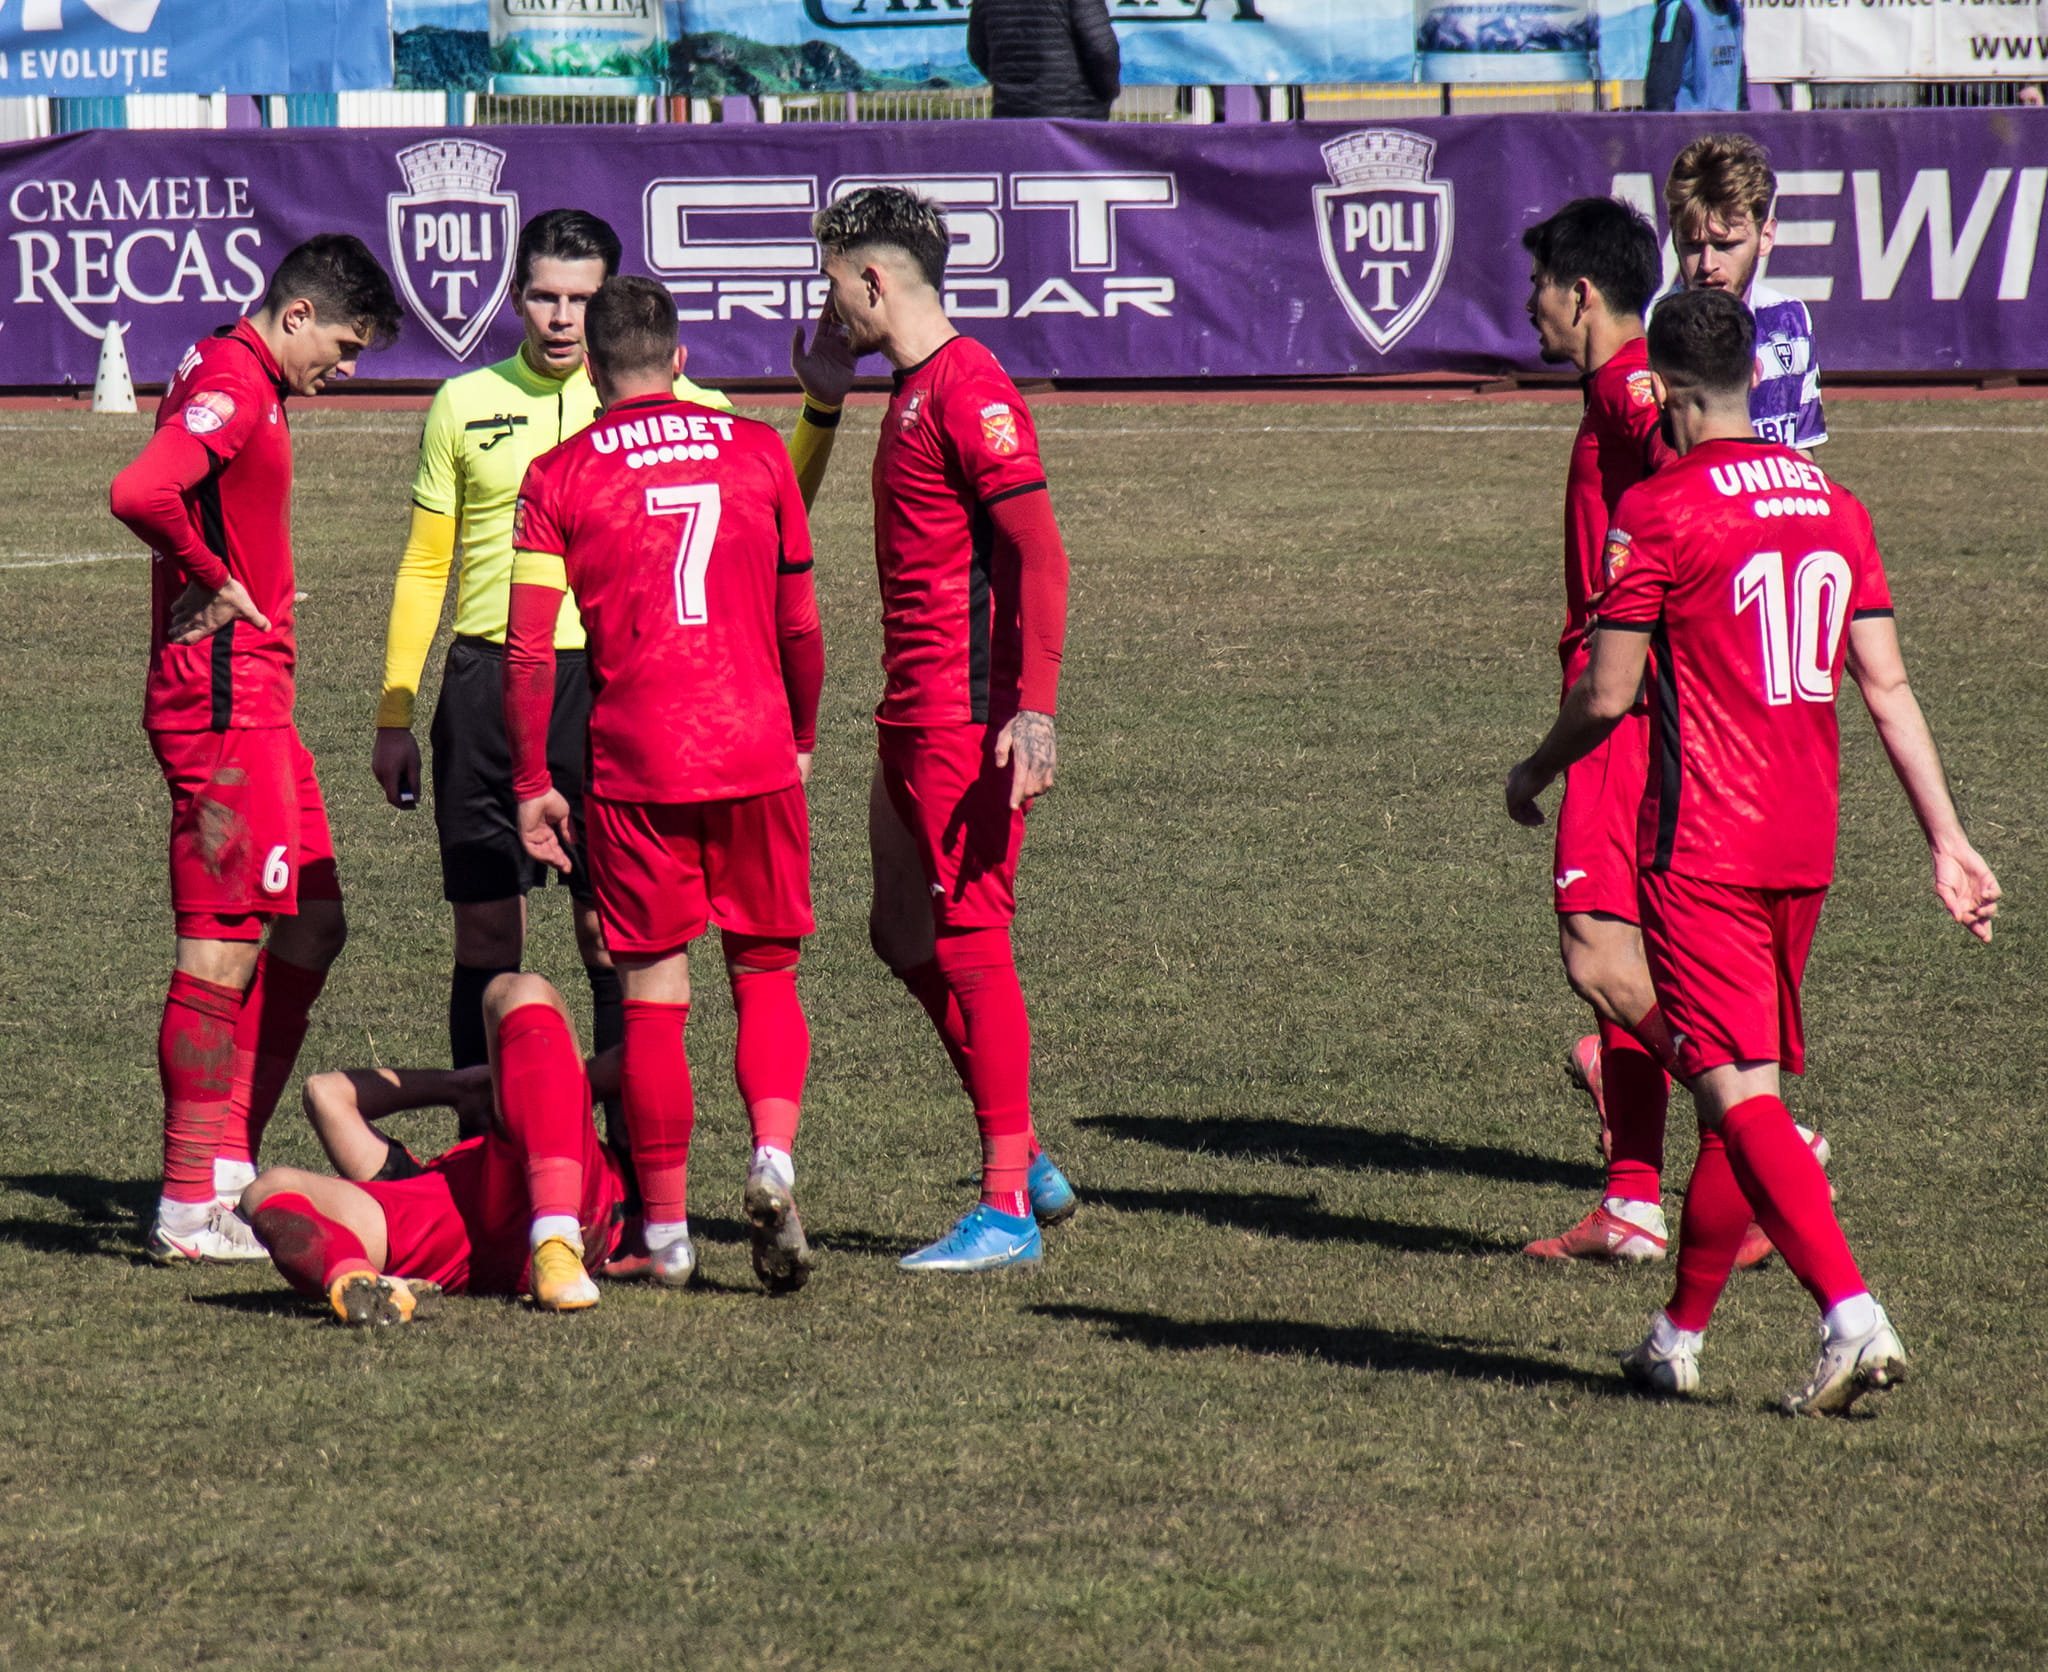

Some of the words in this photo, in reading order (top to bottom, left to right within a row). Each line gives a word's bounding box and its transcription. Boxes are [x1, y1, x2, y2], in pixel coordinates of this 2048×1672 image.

[9, 177, 255, 223] CRAMELE
[415, 213, 492, 262] POLI
[1342, 202, 1426, 252] POLI
[430, 270, 479, 320] T
[1360, 261, 1411, 312] T
[590, 414, 734, 454] UNIBET
[1709, 456, 1831, 496] UNIBET
[646, 483, 722, 626] 7
[1733, 551, 1852, 706] 10
[262, 845, 289, 893] 6
